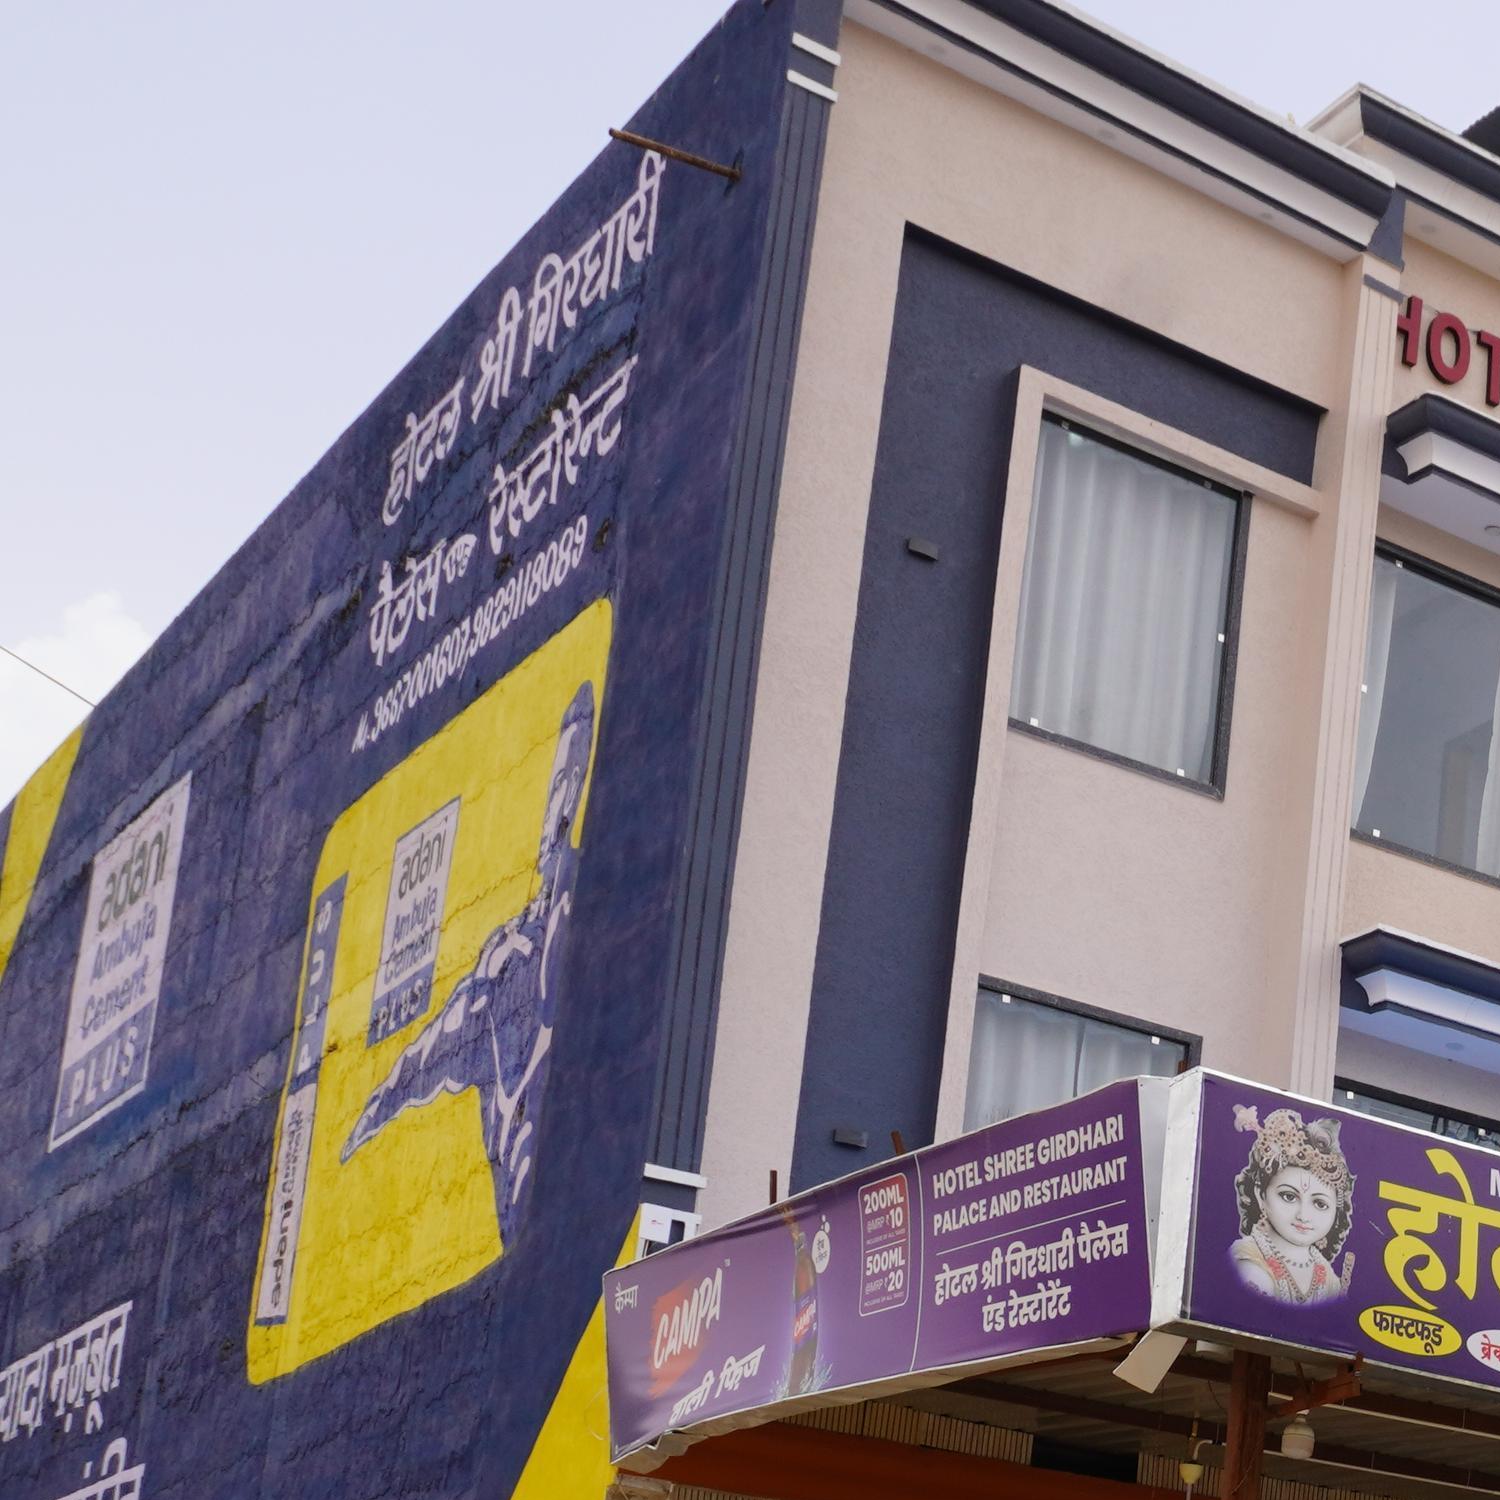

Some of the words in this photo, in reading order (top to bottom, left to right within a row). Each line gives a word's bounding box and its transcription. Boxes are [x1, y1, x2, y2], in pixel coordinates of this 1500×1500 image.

[383, 377, 465, 526] होटल
[471, 286, 523, 423] श्री
[97, 803, 174, 933] adani
[398, 816, 449, 899] adani
[391, 885, 439, 948] Ambuja
[67, 1026, 139, 1119] PLUS
[933, 1160, 983, 1199] HOTEL
[984, 1142, 1035, 1182] SHREE
[1037, 1114, 1124, 1166] GIRDHARI
[933, 1199, 987, 1236] PALACE
[989, 1189, 1022, 1219] AND
[1024, 1156, 1127, 1209] RESTAURANT
[864, 1184, 905, 1214] 200ML
[865, 1246, 906, 1276] 500ML
[934, 1263, 979, 1306] होटल
[980, 1247, 1003, 1290] श्री
[1005, 1227, 1076, 1284] गिरधारी
[1076, 1220, 1129, 1264] पैलेस
[654, 1267, 723, 1369] CAMPA
[982, 1294, 1006, 1333] एंड
[1008, 1278, 1071, 1328] रेस्टोरेंट
[1373, 1309, 1444, 1355] फास्टफूड
